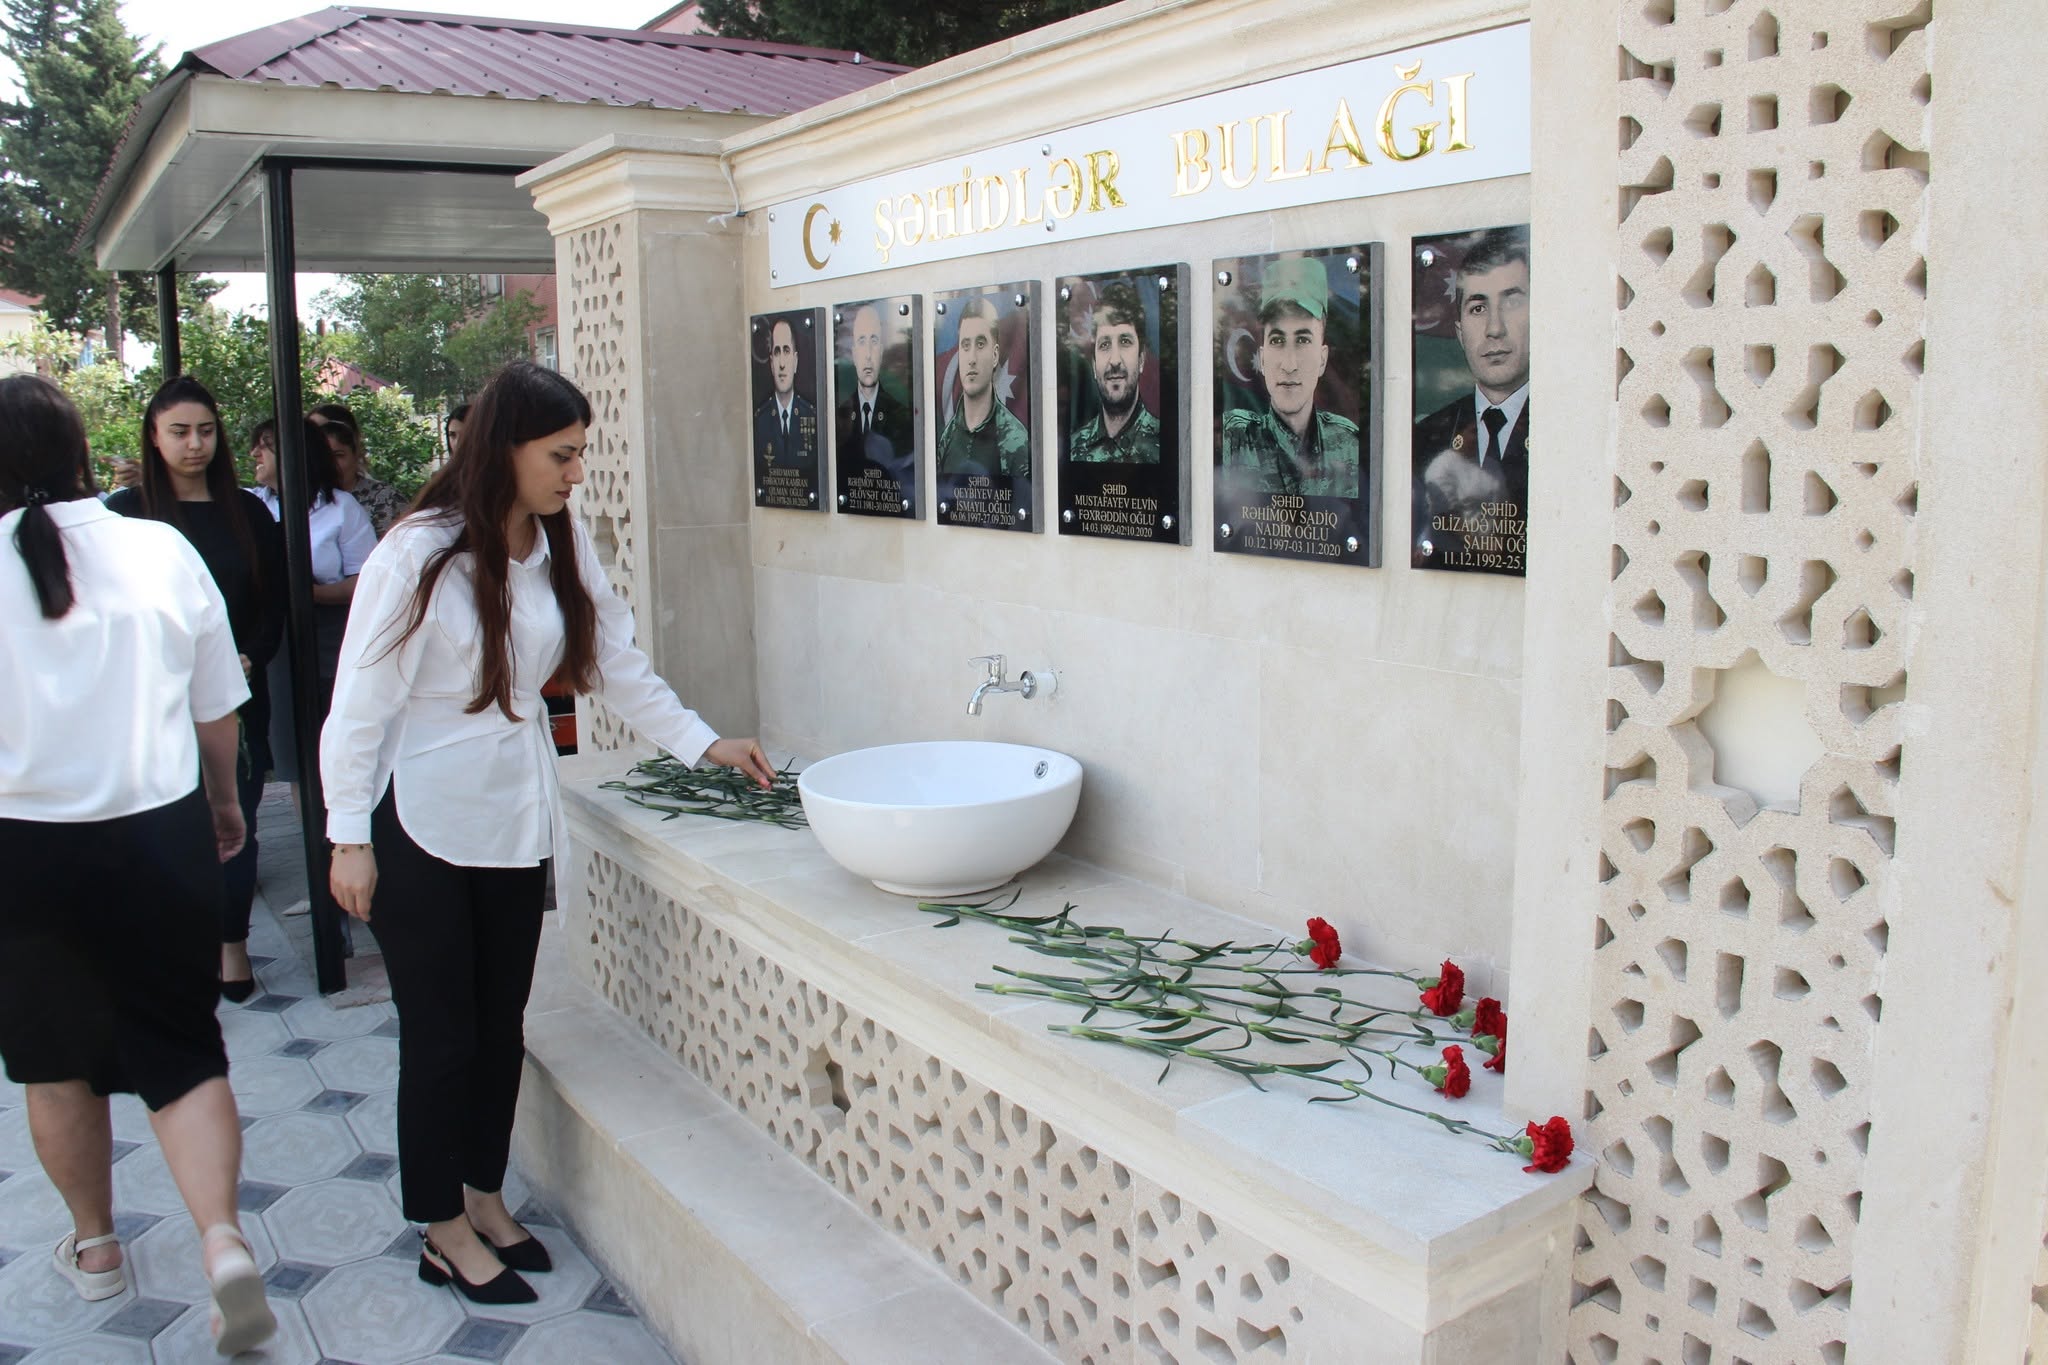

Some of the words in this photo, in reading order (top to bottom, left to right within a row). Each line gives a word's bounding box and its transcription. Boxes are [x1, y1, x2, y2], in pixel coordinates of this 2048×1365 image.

[875, 149, 1127, 264] ŞƏHİDLƏR
[1170, 58, 1476, 198] BULAĞI
[1102, 483, 1127, 496] ŞƏHİD
[988, 500, 1011, 514] OĞLU
[1075, 494, 1130, 509] MUSTAFAYEV
[1131, 497, 1158, 511] ELVİN
[1271, 494, 1304, 509] ŞƏHİD
[1480, 500, 1518, 519] ŞƏHİD
[1078, 509, 1128, 524] FƏXRƏDDİN
[1130, 511, 1155, 526] OĞLU
[1241, 506, 1297, 524] RƏHİMOV
[1299, 509, 1338, 529] SADİQ
[1432, 514, 1489, 533] ƏLİZADƏ
[1492, 517, 1527, 536] MİRZ
[1255, 521, 1292, 538] NADİR
[1295, 523, 1329, 542] OĞLU
[1463, 533, 1503, 552] ŞAHİN
